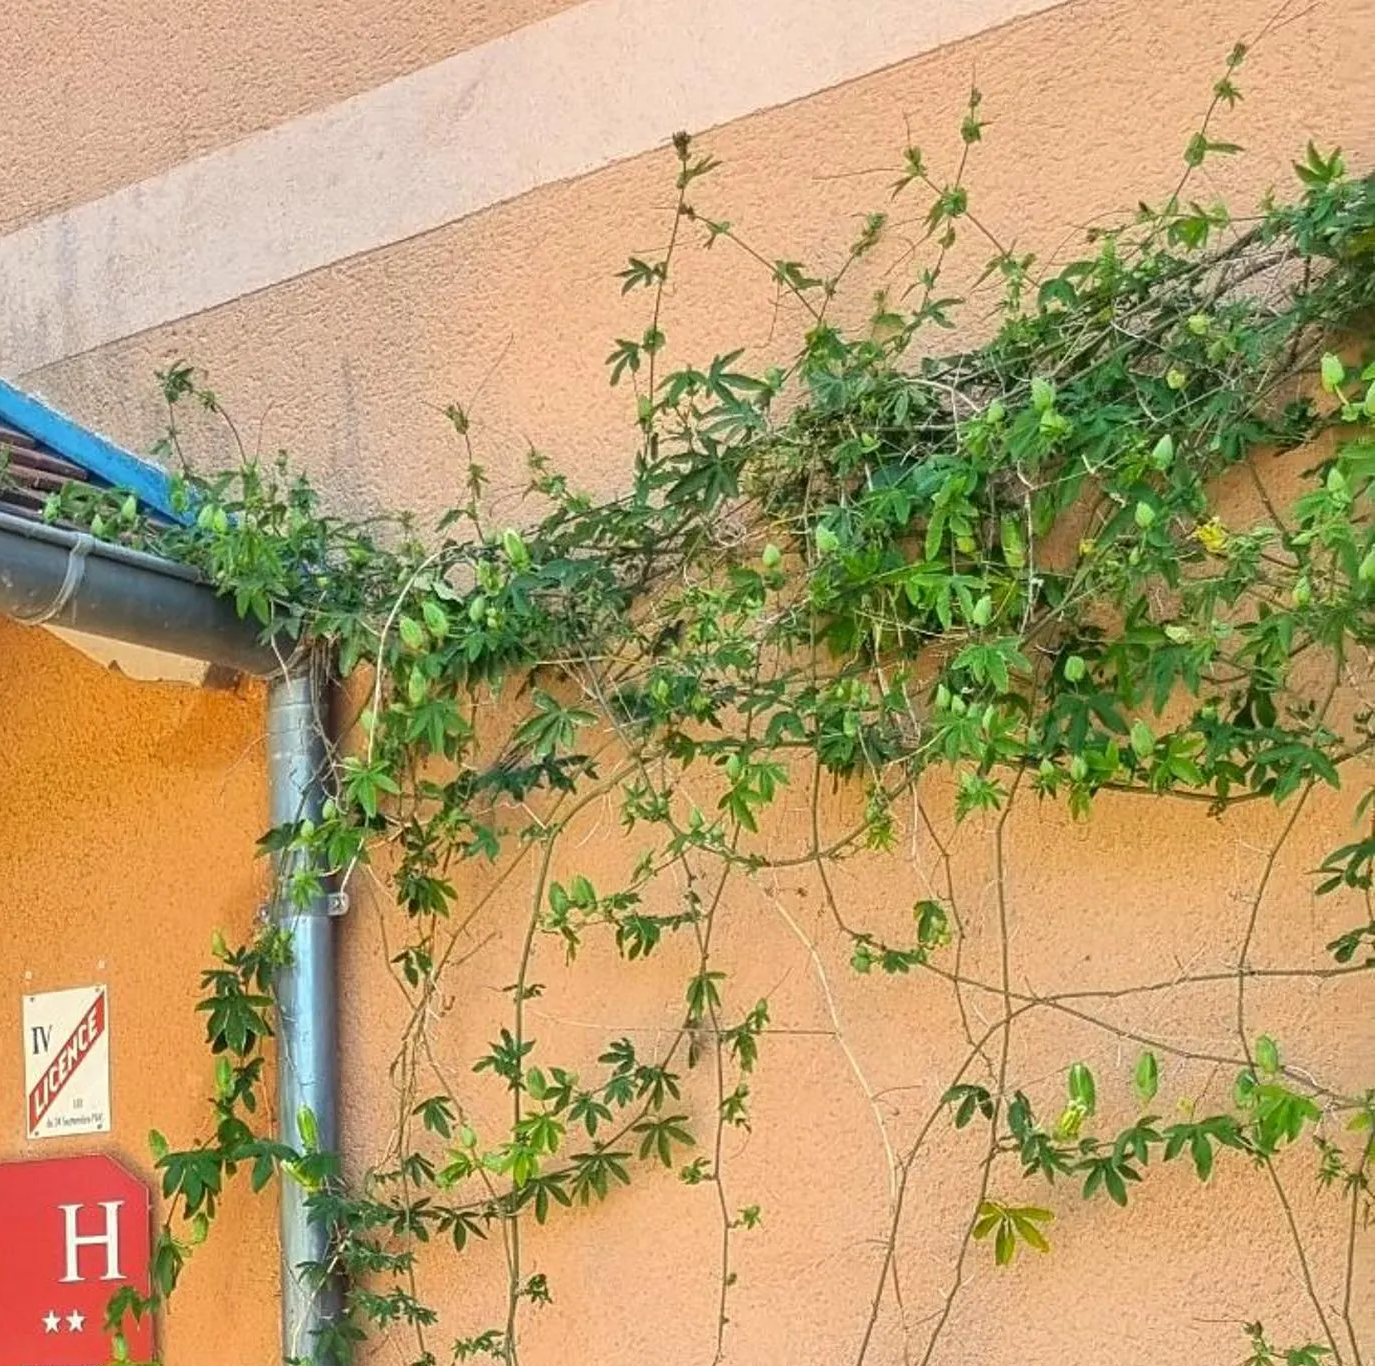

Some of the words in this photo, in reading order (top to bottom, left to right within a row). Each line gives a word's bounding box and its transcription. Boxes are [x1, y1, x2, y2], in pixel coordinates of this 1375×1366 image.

[31, 1025, 53, 1055] IV
[33, 1007, 100, 1118] LICENCE
[57, 1200, 128, 1283] H
